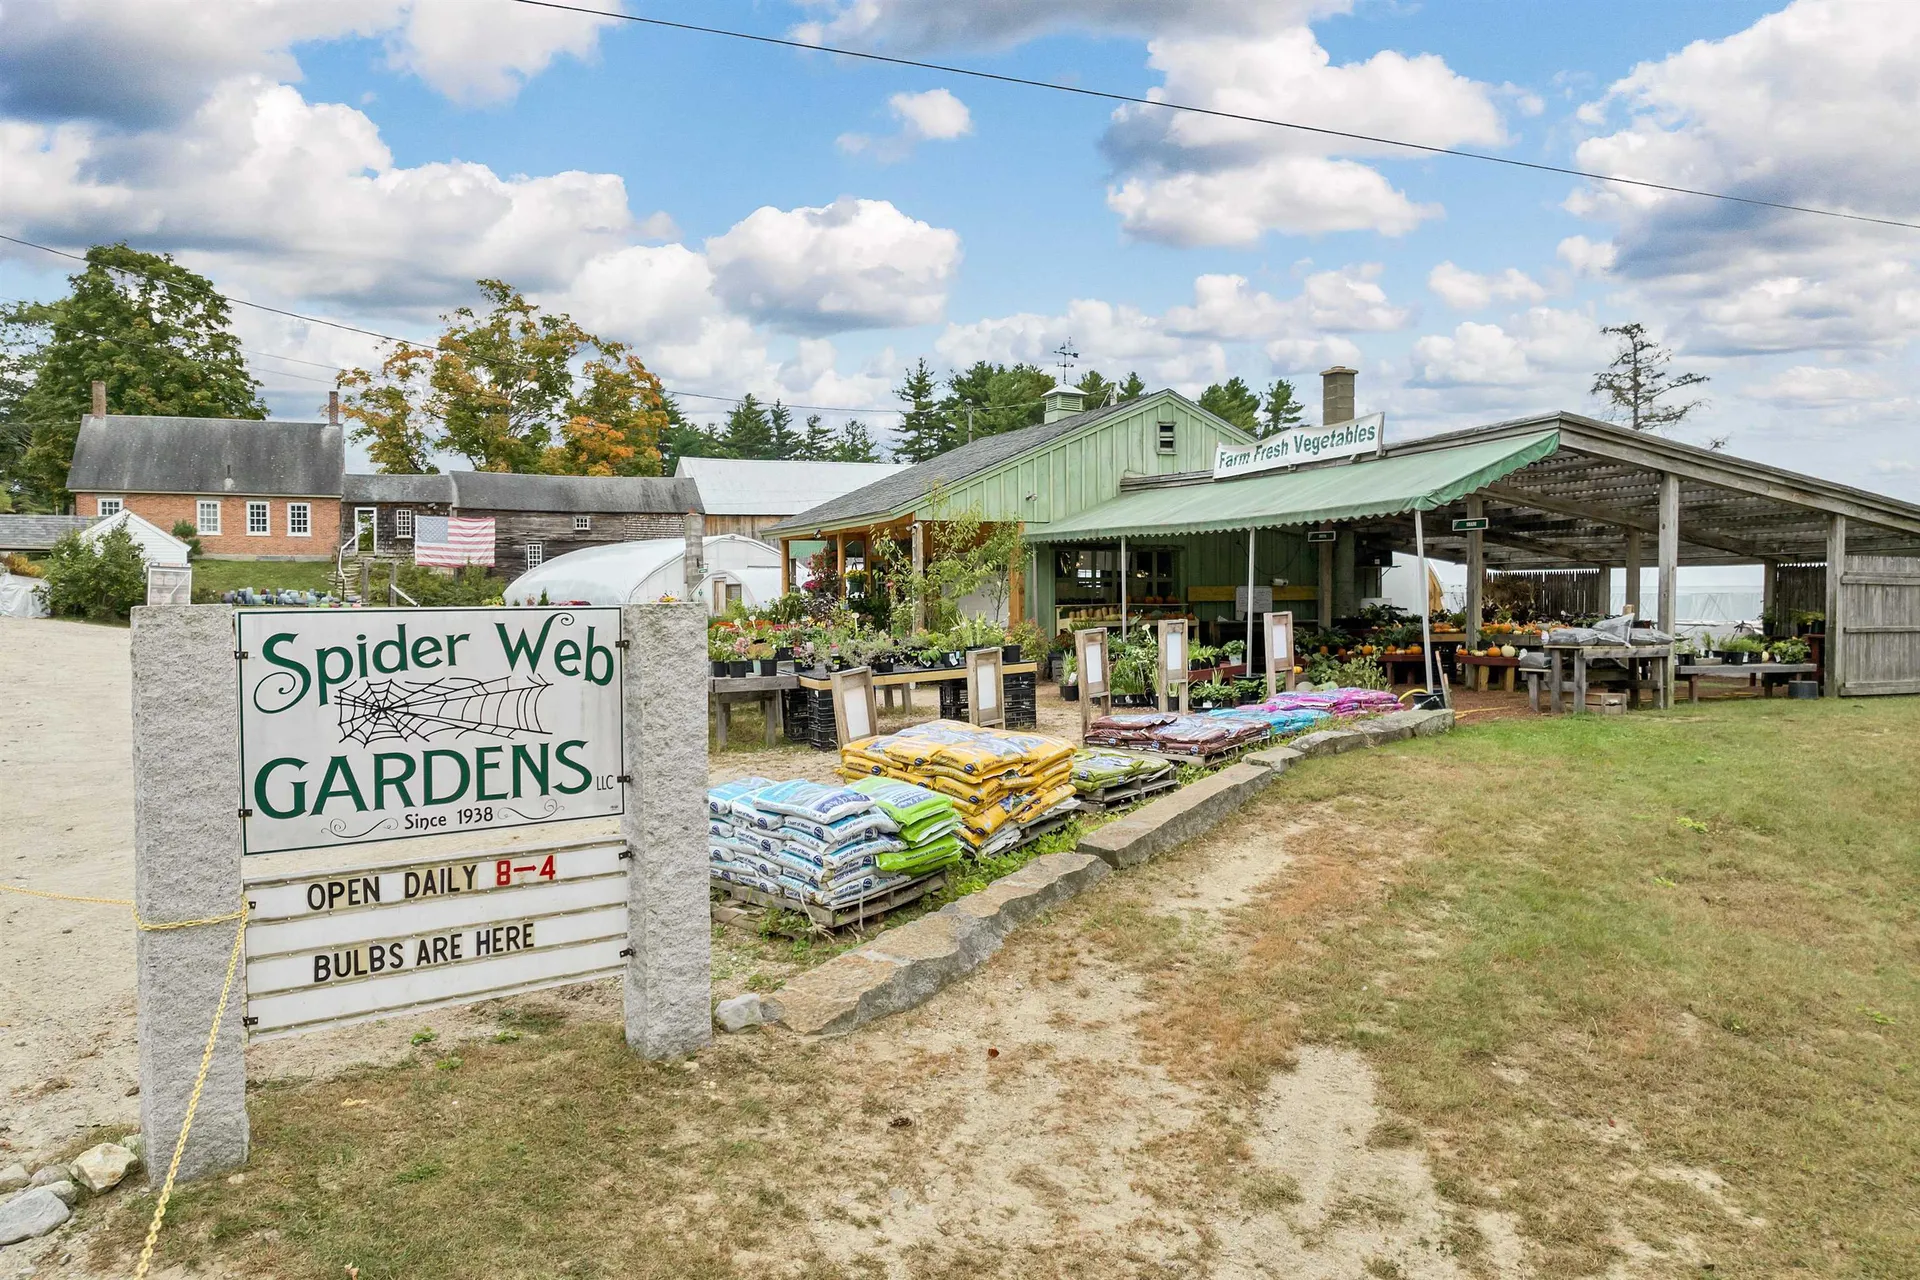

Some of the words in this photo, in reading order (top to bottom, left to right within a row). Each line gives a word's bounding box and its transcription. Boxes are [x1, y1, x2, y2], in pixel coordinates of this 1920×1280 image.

[1218, 449, 1251, 469] Farm
[1252, 438, 1289, 463] Fresh
[1292, 424, 1376, 456] Vegetables
[253, 623, 471, 714] Spider
[496, 612, 615, 686] Web
[253, 739, 593, 820] GARDENS
[596, 775, 613, 791] LLC
[404, 811, 447, 831] Since
[456, 807, 494, 826] 1938
[307, 876, 380, 911] OPEN
[404, 864, 478, 896] DAILY
[313, 941, 404, 983] BULBS
[416, 933, 463, 967] ARE
[476, 923, 535, 957] HERE
